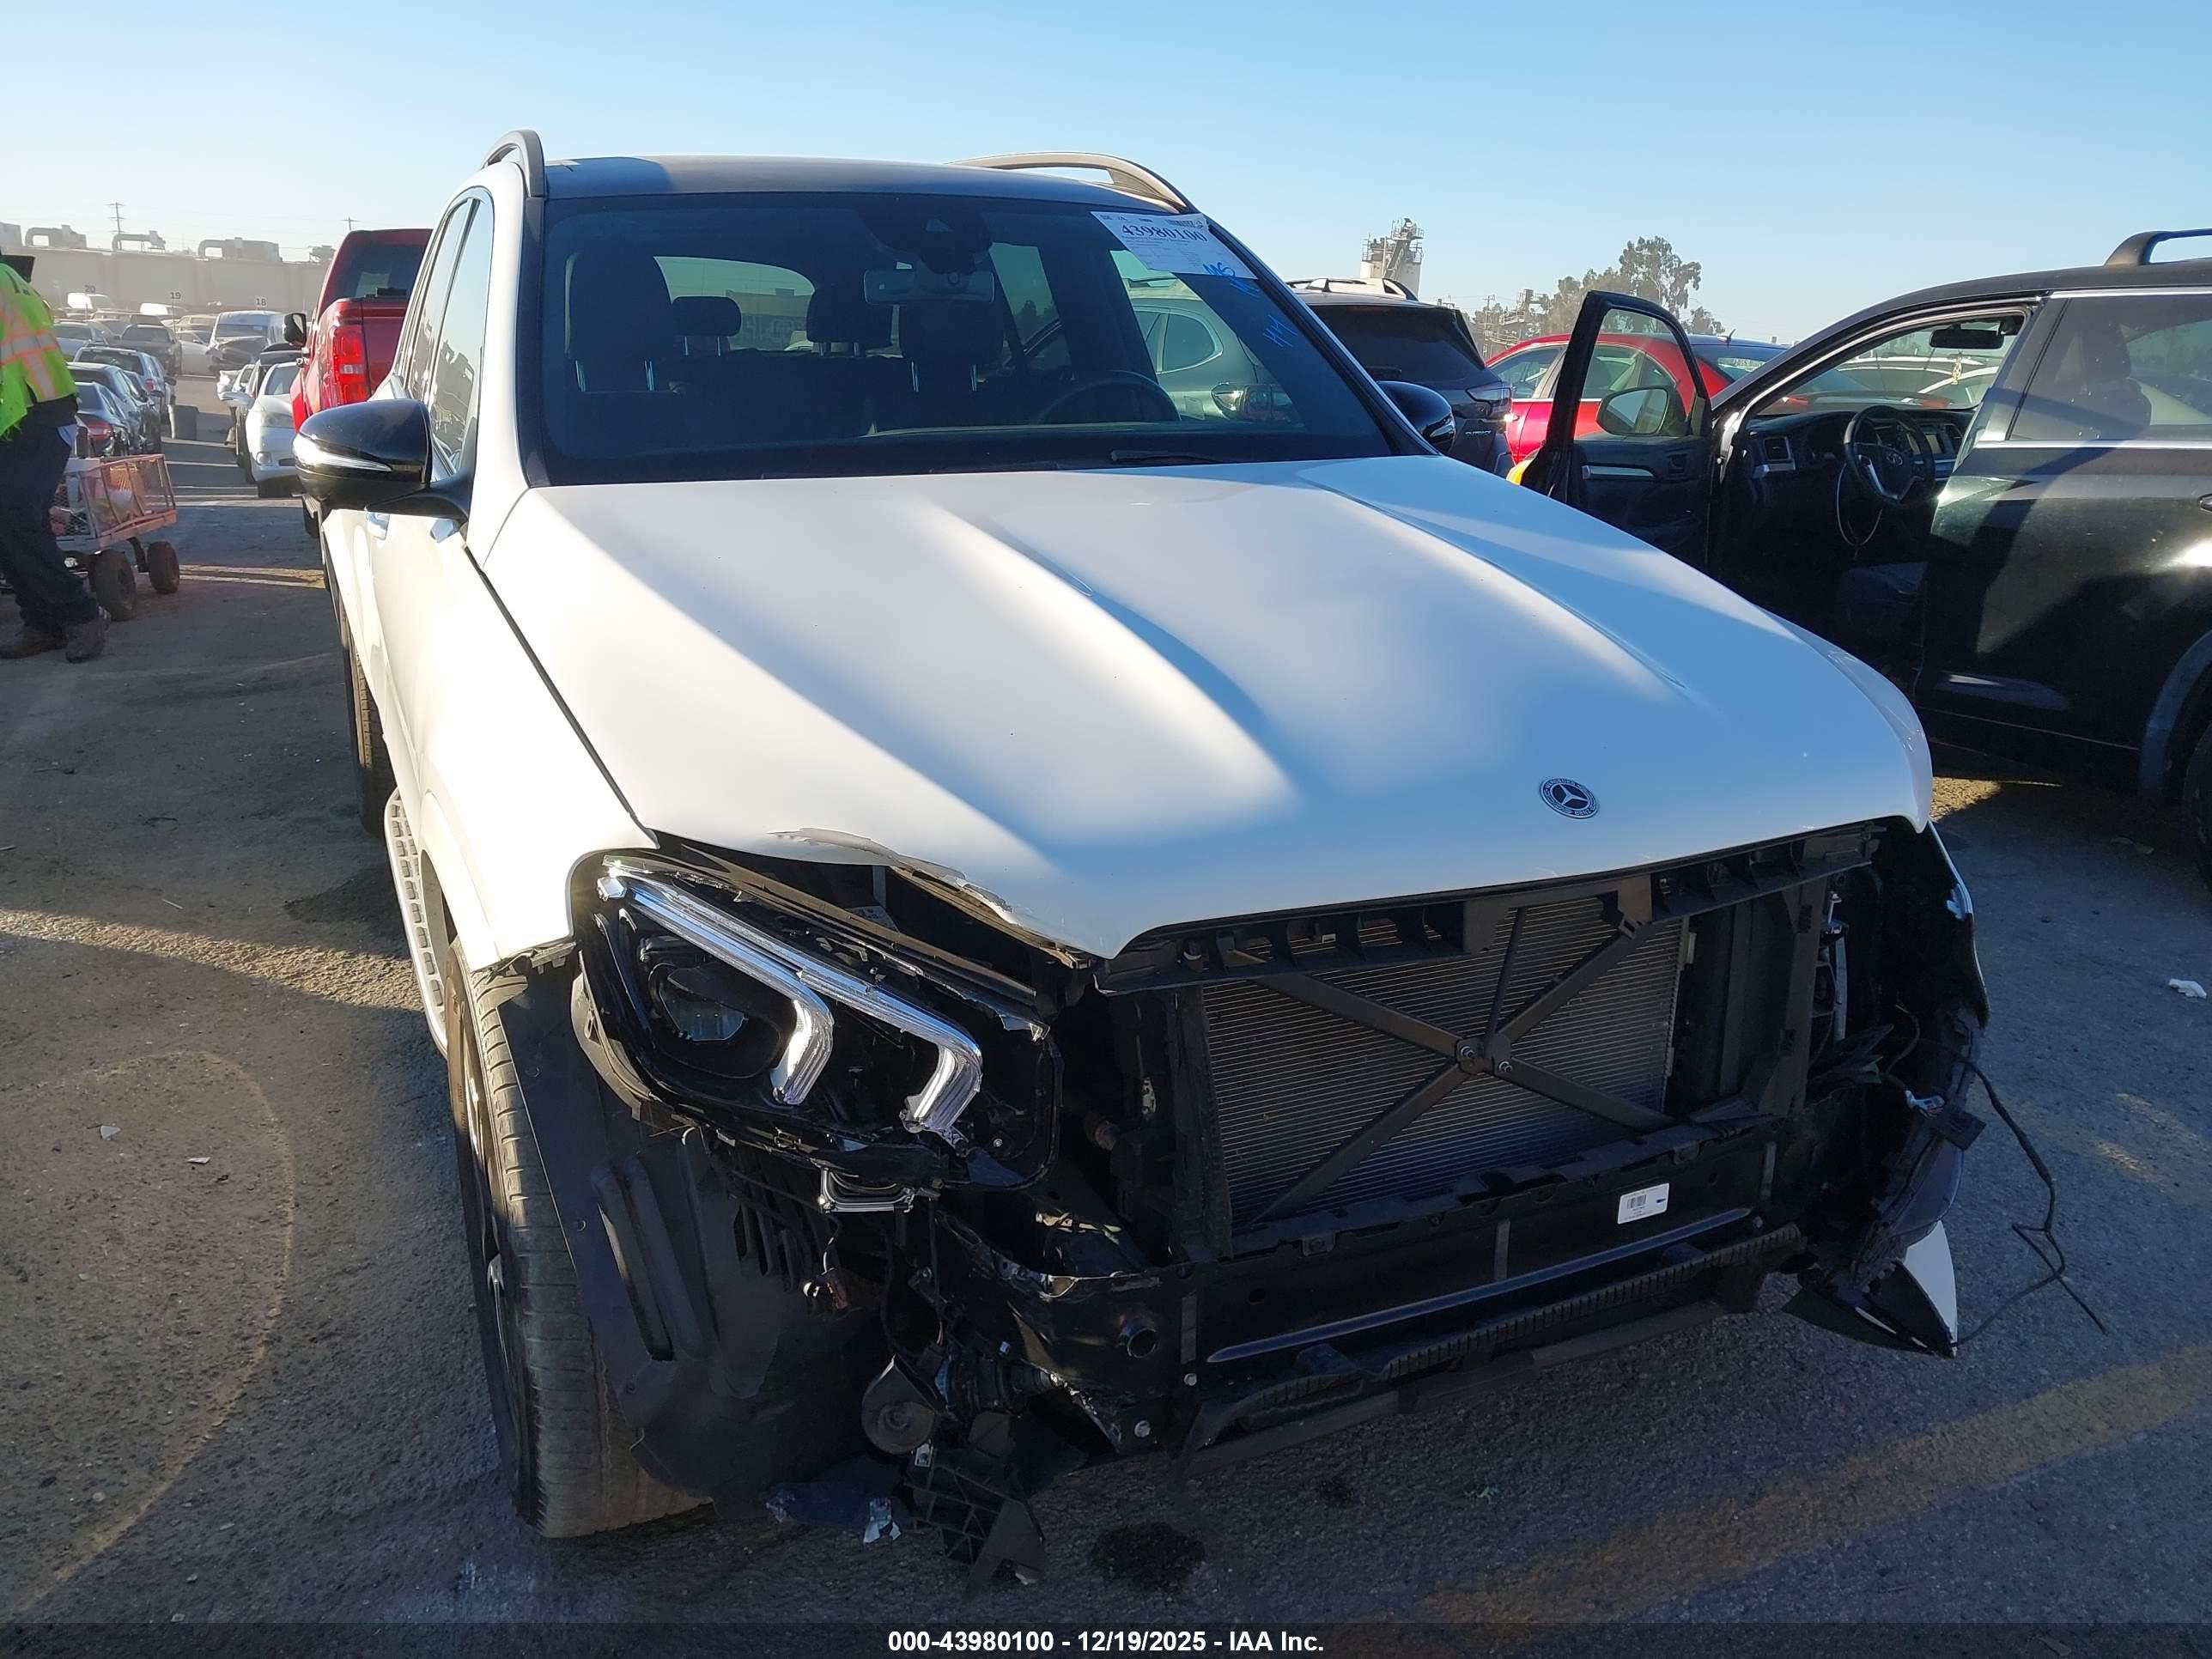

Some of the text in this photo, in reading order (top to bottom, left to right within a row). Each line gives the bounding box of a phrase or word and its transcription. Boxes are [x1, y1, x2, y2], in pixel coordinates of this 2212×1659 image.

[1121, 223, 1208, 243] 43980100
[84, 284, 95, 293] 20
[171, 291, 181, 300] 19
